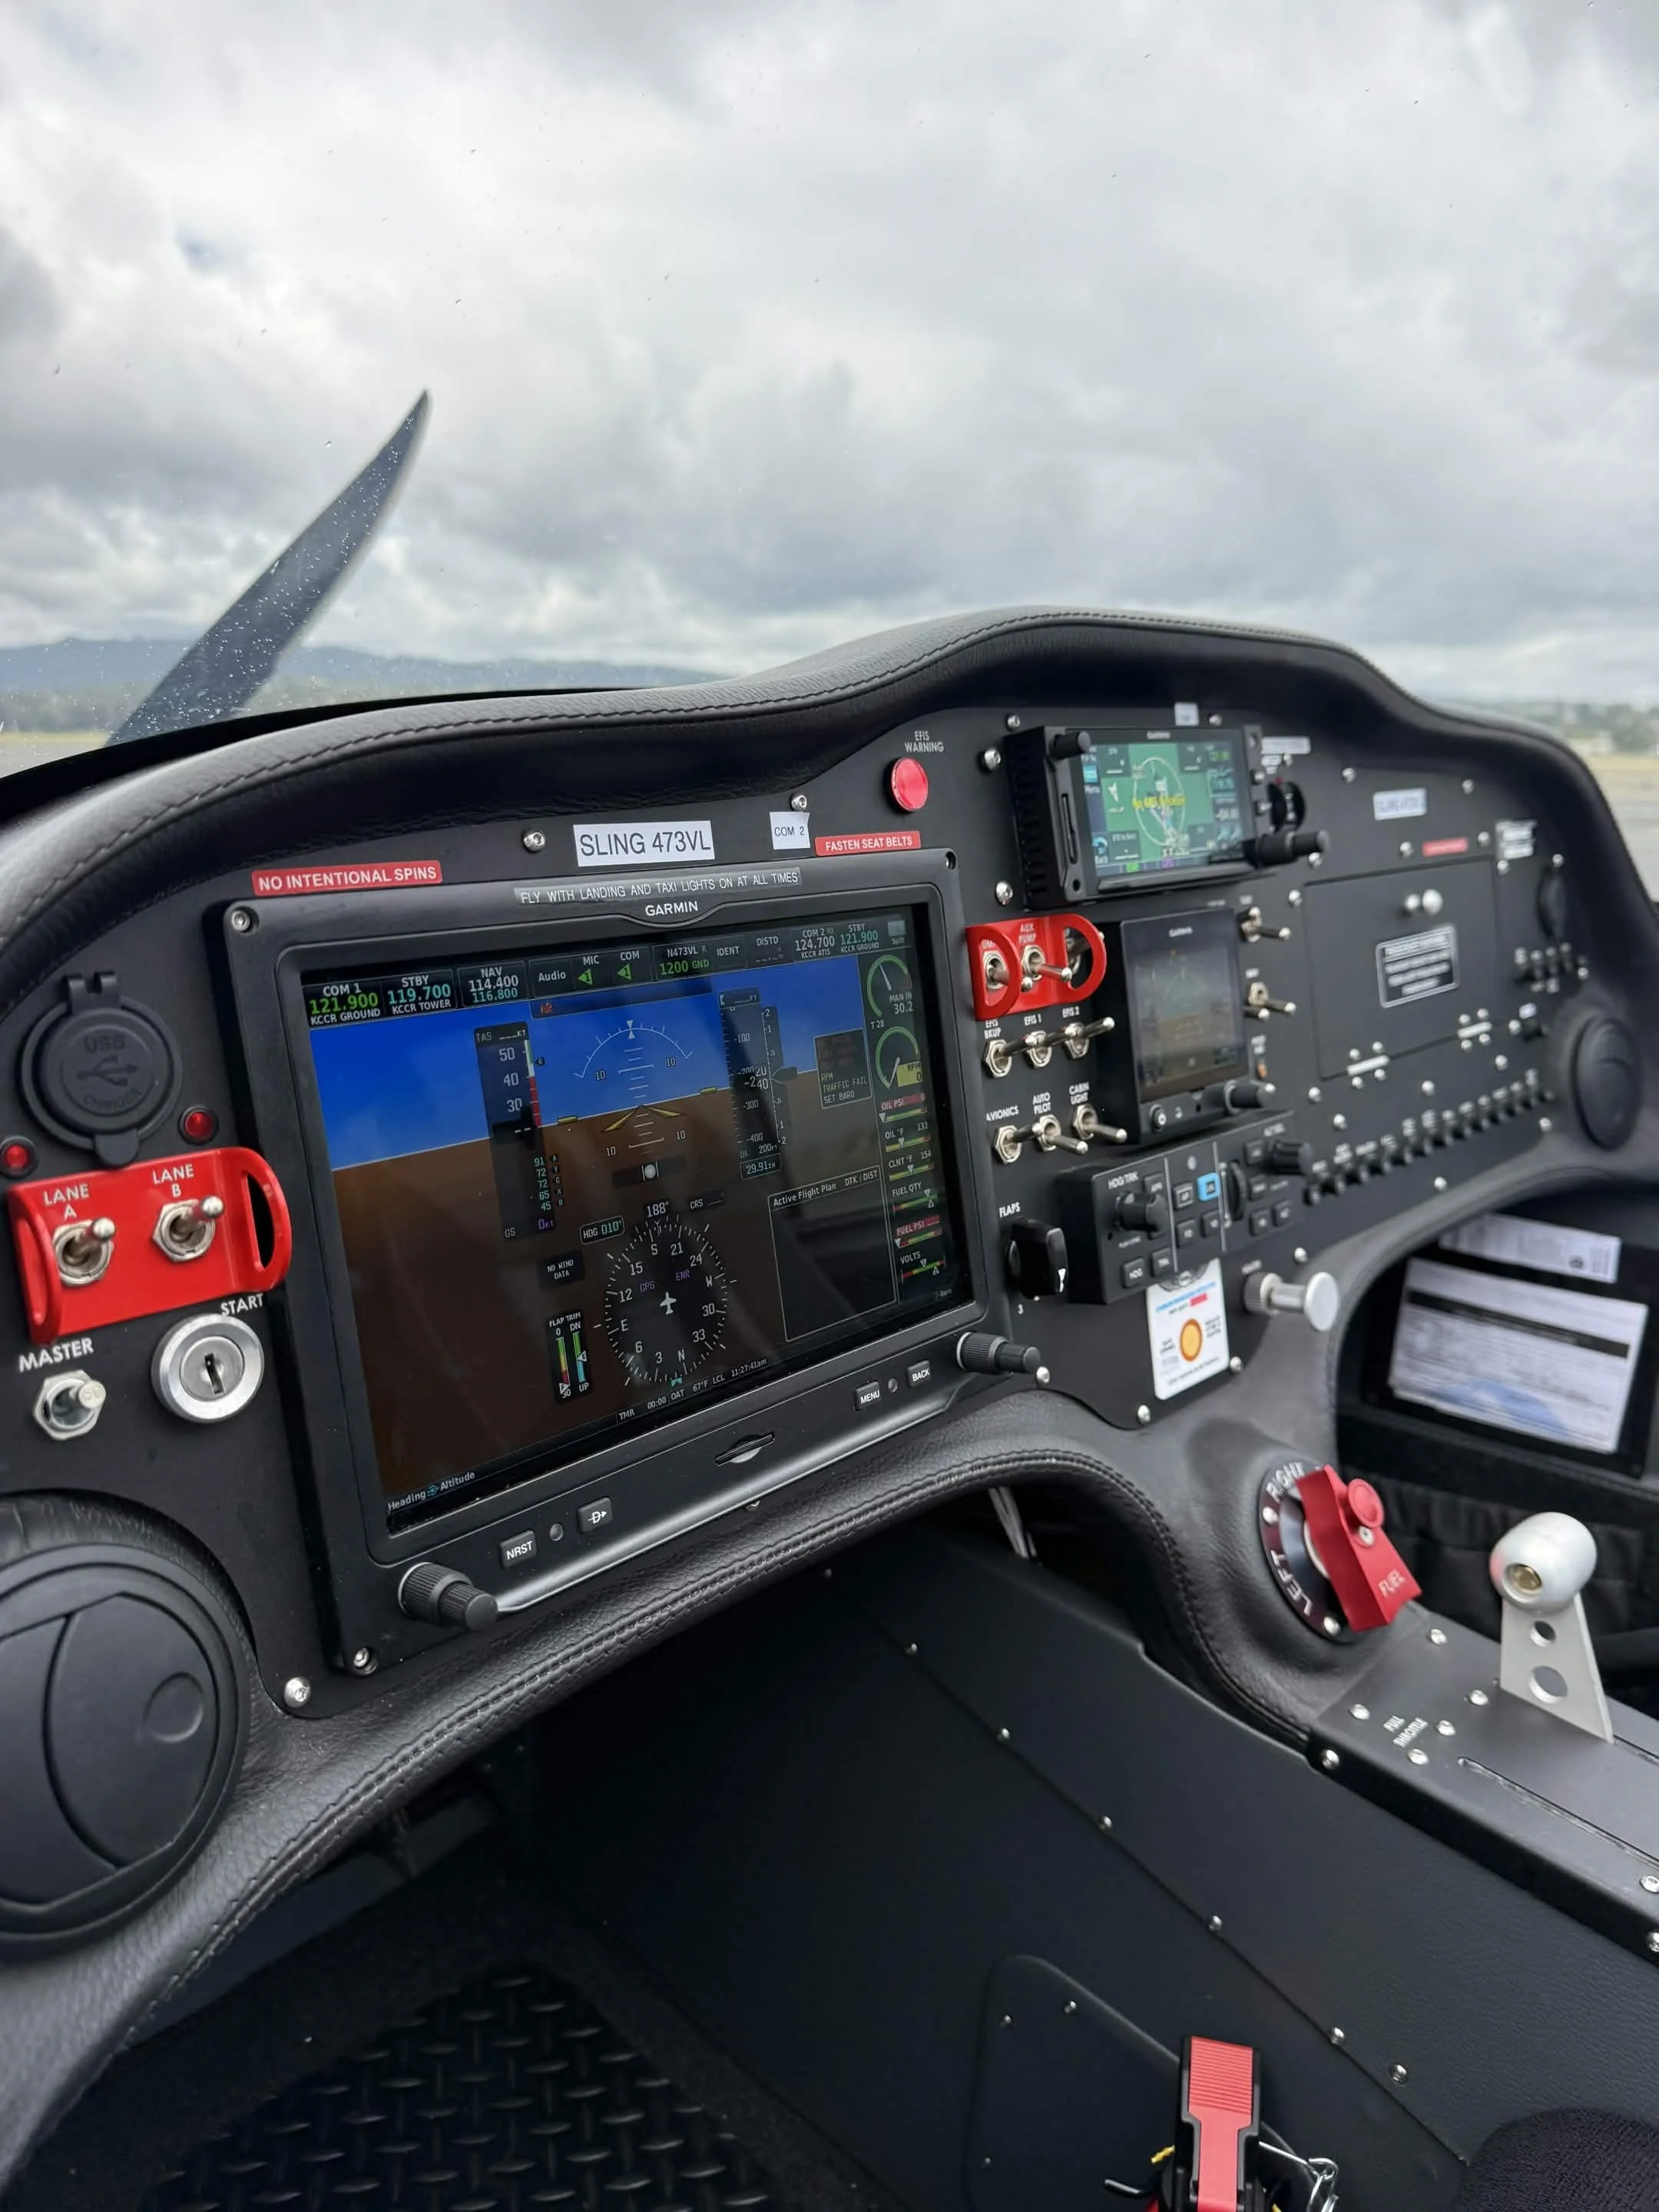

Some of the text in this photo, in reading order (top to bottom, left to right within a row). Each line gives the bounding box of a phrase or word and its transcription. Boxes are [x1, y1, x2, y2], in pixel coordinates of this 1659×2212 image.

[914, 730, 930, 742] EFIS
[904, 741, 945, 753] WARNING
[773, 826, 805, 837] COM 2
[579, 830, 711, 857] SLING 473VL
[825, 835, 912, 852] FASTEN SEAT BELTS
[258, 866, 437, 892] NO INTENTIONAL SPINS
[521, 871, 799, 904] FLY WITH LANDING AND TAXI LIGHTS ON AT ALL TIMES
[644, 900, 699, 917] GARMIN
[802, 928, 818, 939] COM
[847, 922, 866, 933] STBY
[794, 935, 836, 952] 124.700
[839, 929, 879, 945] 121.900
[620, 949, 641, 962] COM
[666, 947, 699, 959] N473VL
[716, 945, 740, 957] IDENT
[801, 947, 831, 959] KCCR ATIS
[840, 942, 880, 954] KCCR GROUND
[582, 955, 600, 966] MIC
[659, 959, 710, 976] 1200 GND
[480, 966, 503, 978] NAV
[538, 969, 567, 983] Audio
[401, 974, 430, 988] STBY
[468, 974, 520, 992] 114.400
[323, 982, 362, 998] COM 1
[386, 983, 452, 1005] 119.700
[472, 987, 518, 1004] 116.800
[889, 992, 904, 1003] MAN
[309, 991, 379, 1015] 121.900
[392, 998, 452, 1015] KCCR TOWER
[893, 1001, 914, 1015] 30.2
[310, 1007, 382, 1026] KCCR GROUND
[876, 1018, 885, 1029] 28
[475, 1031, 492, 1042] TAS
[84, 1036, 127, 1053] USB
[498, 1047, 515, 1062] 50
[666, 1057, 676, 1068] 10
[503, 1072, 520, 1088] 40
[595, 1070, 606, 1081] 10
[823, 1076, 867, 1093] TRAFFIC FAIL
[1068, 1081, 1091, 1097] CABIN
[823, 1090, 855, 1104] SET BARO
[880, 1098, 905, 1111] OIL PSI
[1032, 1091, 1051, 1106] AUTO
[506, 1098, 522, 1113] 30
[1033, 1101, 1051, 1115] PILOT
[985, 1104, 1020, 1123] AVIONICS
[676, 1130, 687, 1141] 10
[884, 1121, 929, 1140] OIL 133
[605, 1146, 617, 1157] 10
[534, 1157, 545, 1167] 91
[888, 1157, 905, 1168] CLNT
[151, 1163, 195, 1185] LANE
[536, 1168, 547, 1178] 72
[844, 1169, 878, 1187] DTK DIST
[171, 1183, 182, 1198] B
[538, 1180, 548, 1189] 72
[892, 1181, 922, 1198] FUEL QTY
[43, 1183, 91, 1207] LANE
[538, 1190, 551, 1201] 65
[773, 1181, 837, 1207] Active Flight Plan
[540, 1201, 551, 1212] 45
[689, 1198, 704, 1210] CRS
[998, 1201, 1021, 1218] FLAPS
[63, 1204, 78, 1220] A
[504, 1227, 516, 1238] GS
[582, 1227, 598, 1240] HDG
[896, 1220, 925, 1237] FUEL PSI
[651, 1243, 658, 1257] S
[670, 1241, 684, 1257] 21
[689, 1253, 704, 1267] 24
[899, 1250, 922, 1265] VOLTS
[546, 1258, 575, 1273] NO WIND
[629, 1260, 644, 1277] 15
[554, 1270, 570, 1280] DATA
[705, 1274, 714, 1288] W
[618, 1287, 634, 1303] 12
[220, 1293, 264, 1316] START
[701, 1302, 717, 1317] 30
[548, 1311, 581, 1329] FLAP TRIM
[569, 1320, 581, 1332] DN
[620, 1319, 629, 1332] E
[555, 1327, 562, 1336] 0
[691, 1328, 707, 1343] 33
[18, 1336, 94, 1373] MASTER
[634, 1340, 644, 1354] 6
[655, 1350, 664, 1364] 3
[677, 1348, 687, 1362] N
[911, 1366, 932, 1382] BACK
[578, 1382, 590, 1392] UP
[618, 1408, 636, 1422] TMR
[647, 1396, 667, 1410] 00:00
[671, 1388, 685, 1401] OAT
[711, 1373, 727, 1386] LCL
[859, 1389, 881, 1406] MENU
[386, 1469, 476, 1514] Heading Altitude
[505, 1540, 535, 1561] NRST
[1270, 1549, 1314, 1617] LEFT
[1377, 1568, 1408, 1598] FUEL
